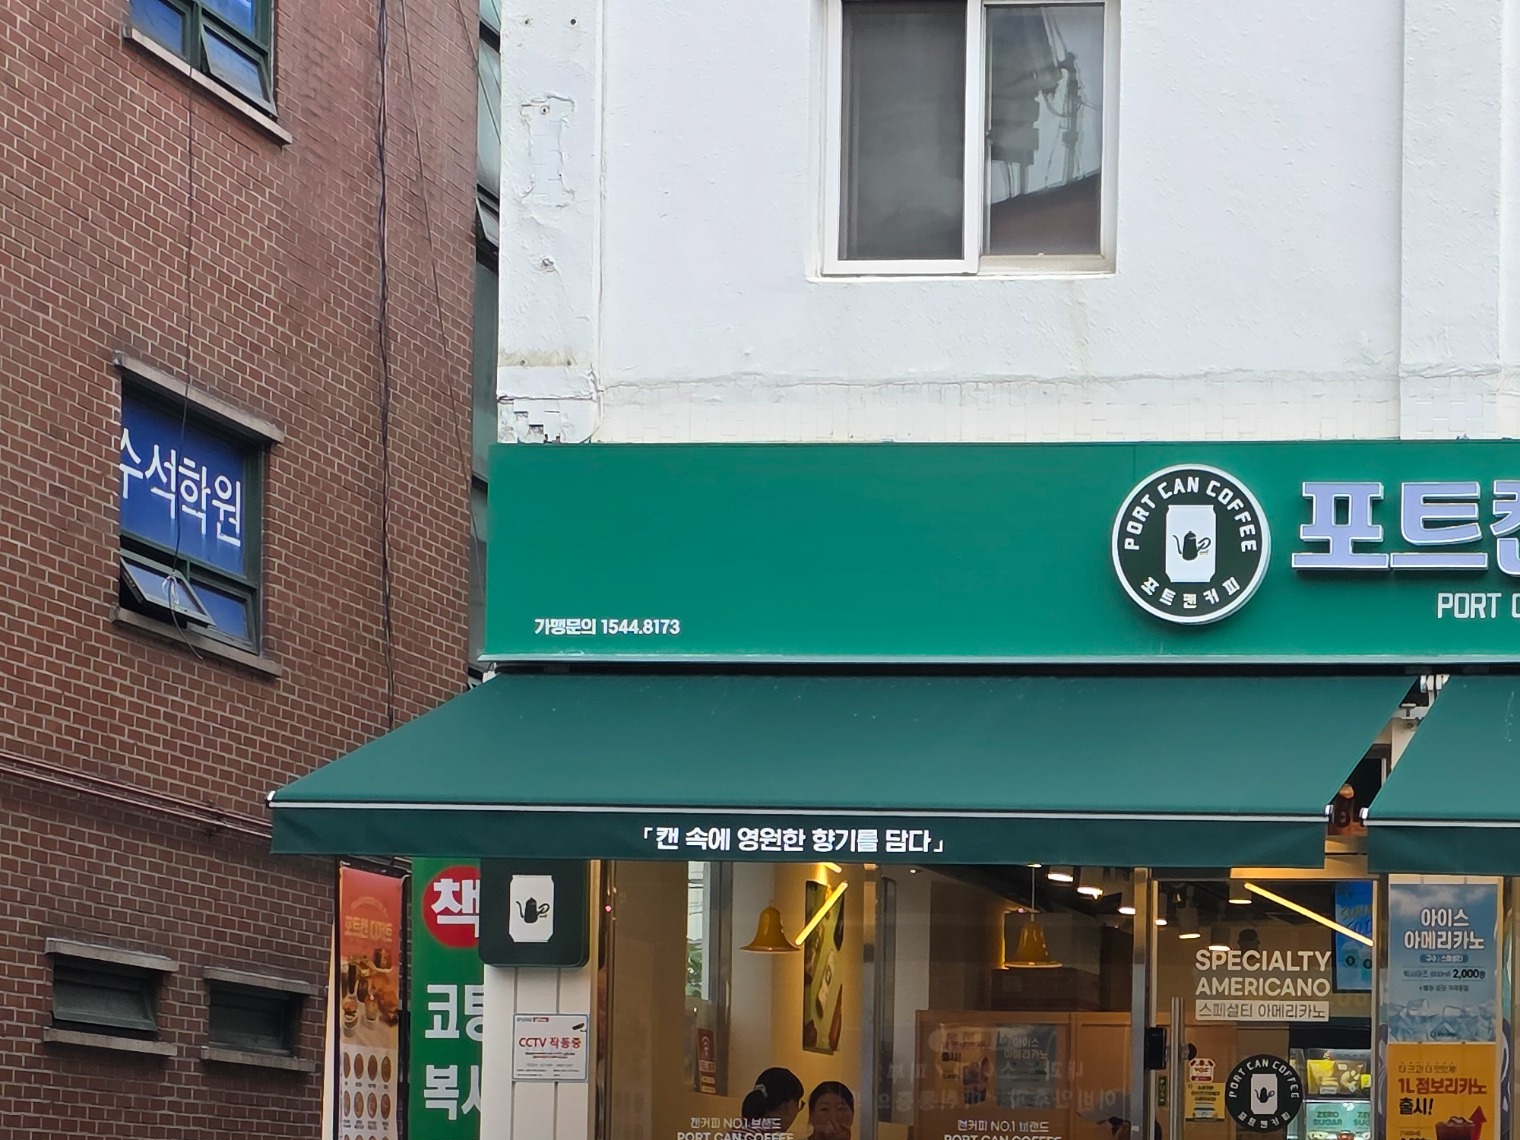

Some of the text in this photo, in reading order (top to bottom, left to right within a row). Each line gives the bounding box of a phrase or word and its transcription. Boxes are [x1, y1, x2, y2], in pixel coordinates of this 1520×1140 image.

[1124, 476, 1257, 552] PORT CAN COFFEE
[1436, 592, 1499, 619] PORT
[534, 618, 681, 636] 가맹문의 1544.8173
[685, 827, 731, 851] 속에
[737, 827, 806, 852] 영원한
[811, 828, 879, 853] 향기를
[431, 877, 480, 938] 책
[1421, 908, 1470, 928] 아이스
[1404, 930, 1485, 950] 아메리카노
[1195, 949, 1332, 972] SPECIALTY
[1195, 977, 1331, 997] AMERICANO
[1258, 1003, 1326, 1019] 아메리카노
[518, 1037, 547, 1049] CCTV
[1228, 1068, 1246, 1098] PORT
[1246, 1059, 1269, 1071] CAN
[1398, 1097, 1434, 1116] 출시!
[991, 1120, 1016, 1132] NO.1
